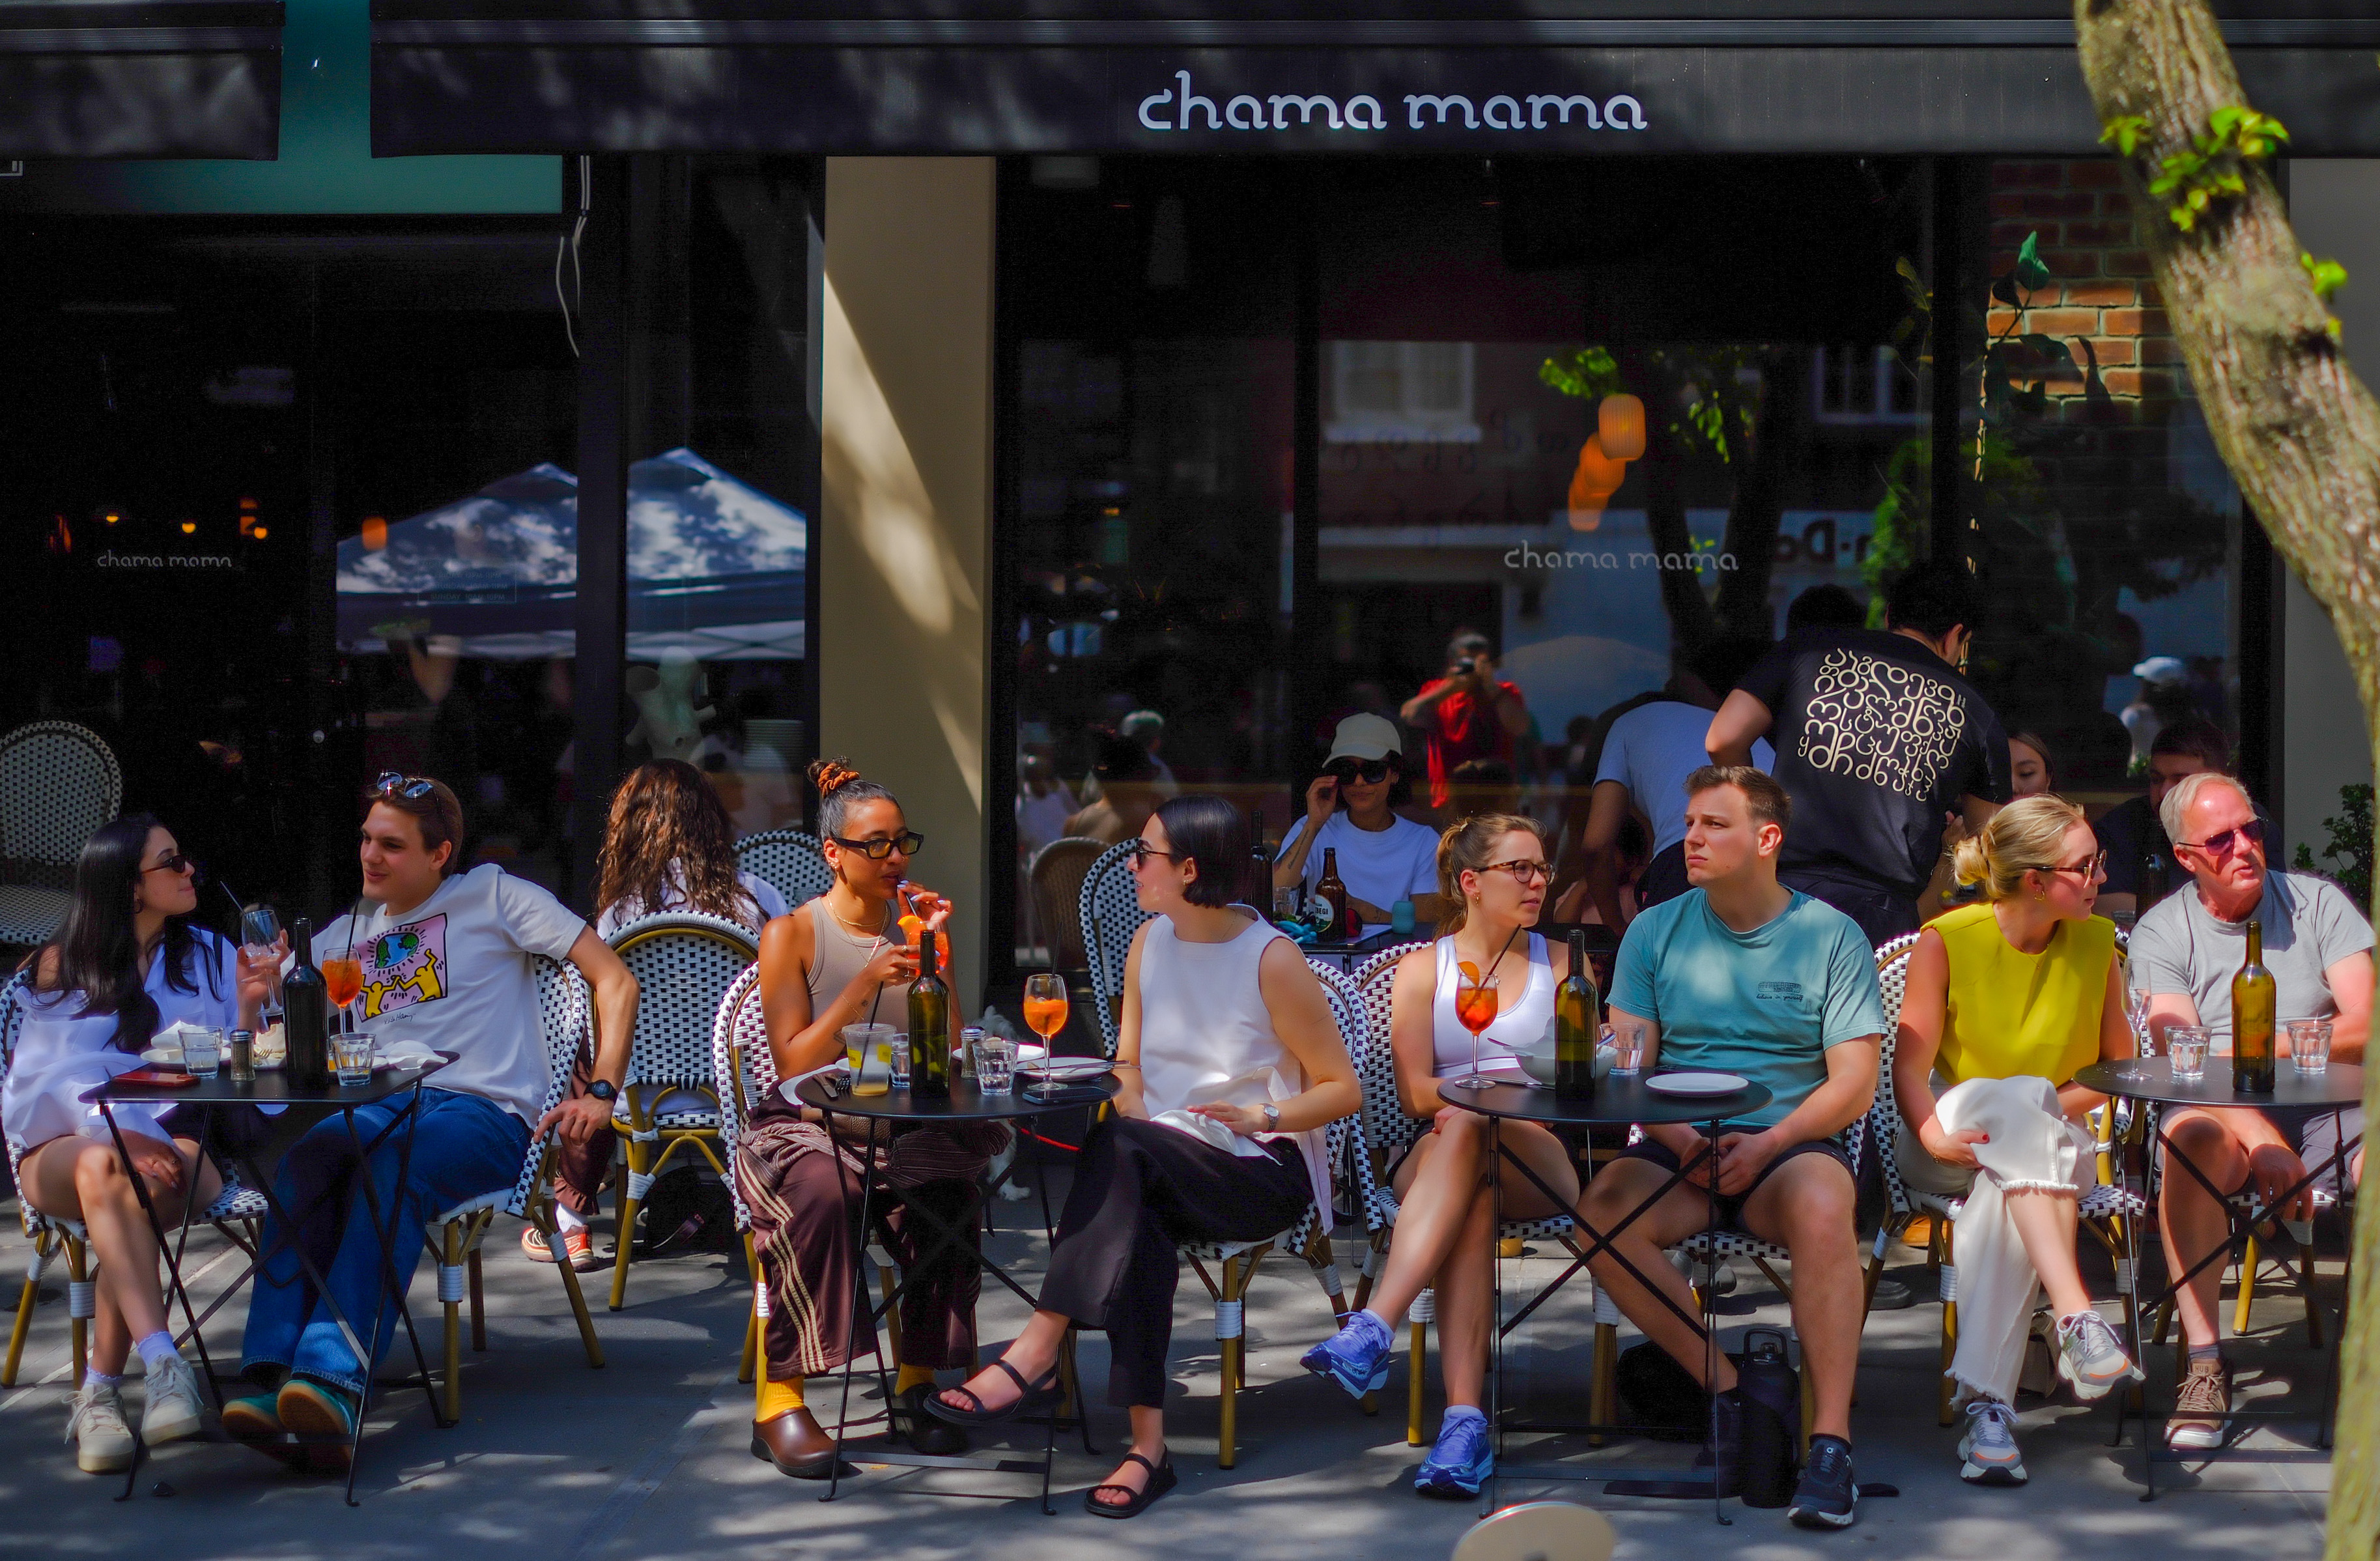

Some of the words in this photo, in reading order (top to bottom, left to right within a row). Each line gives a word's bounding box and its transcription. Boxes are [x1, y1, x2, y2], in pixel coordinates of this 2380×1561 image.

[1139, 70, 1387, 130] chama
[1404, 94, 1648, 130] mama
[98, 549, 163, 567] chama
[1504, 540, 1619, 570] chama
[1628, 552, 1738, 570] mama
